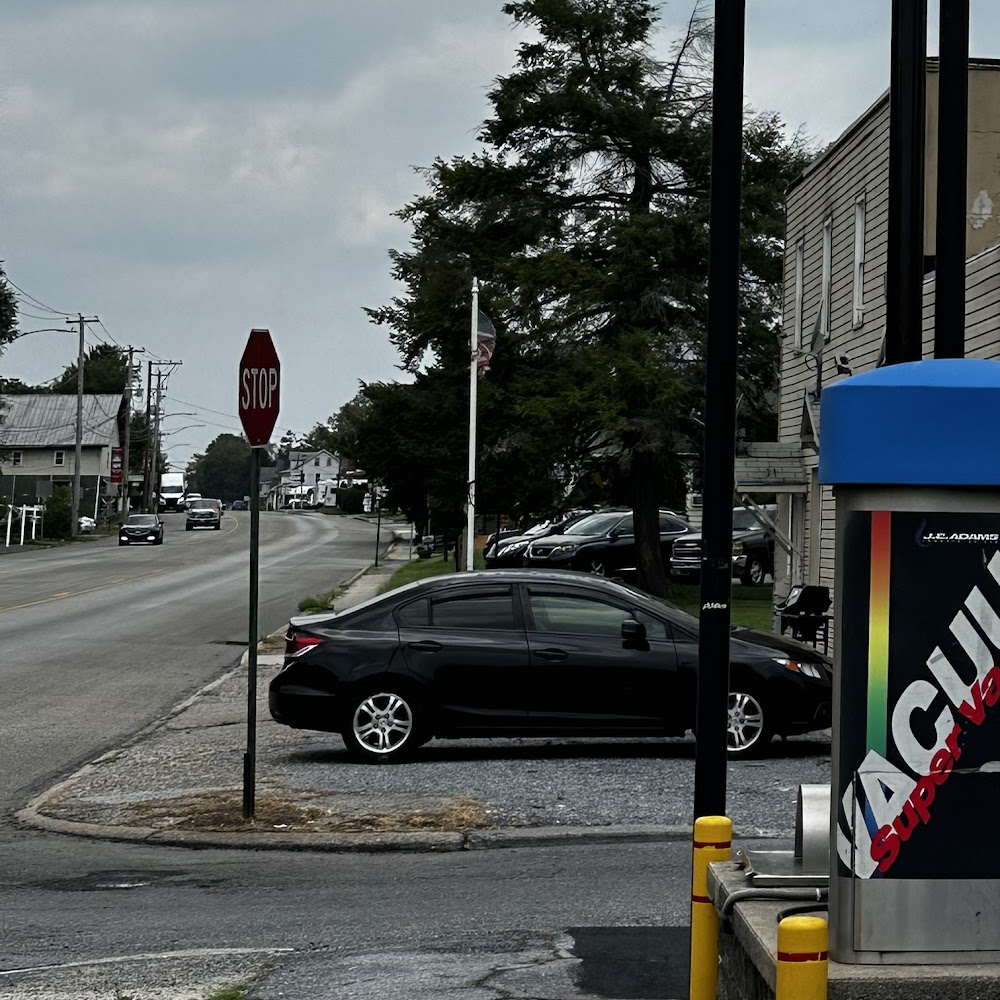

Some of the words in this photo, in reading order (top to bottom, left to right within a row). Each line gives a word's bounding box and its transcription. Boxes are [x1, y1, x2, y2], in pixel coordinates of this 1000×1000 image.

[242, 366, 278, 410] STOP
[949, 532, 999, 540] ADAMS
[870, 723, 962, 873] Super
